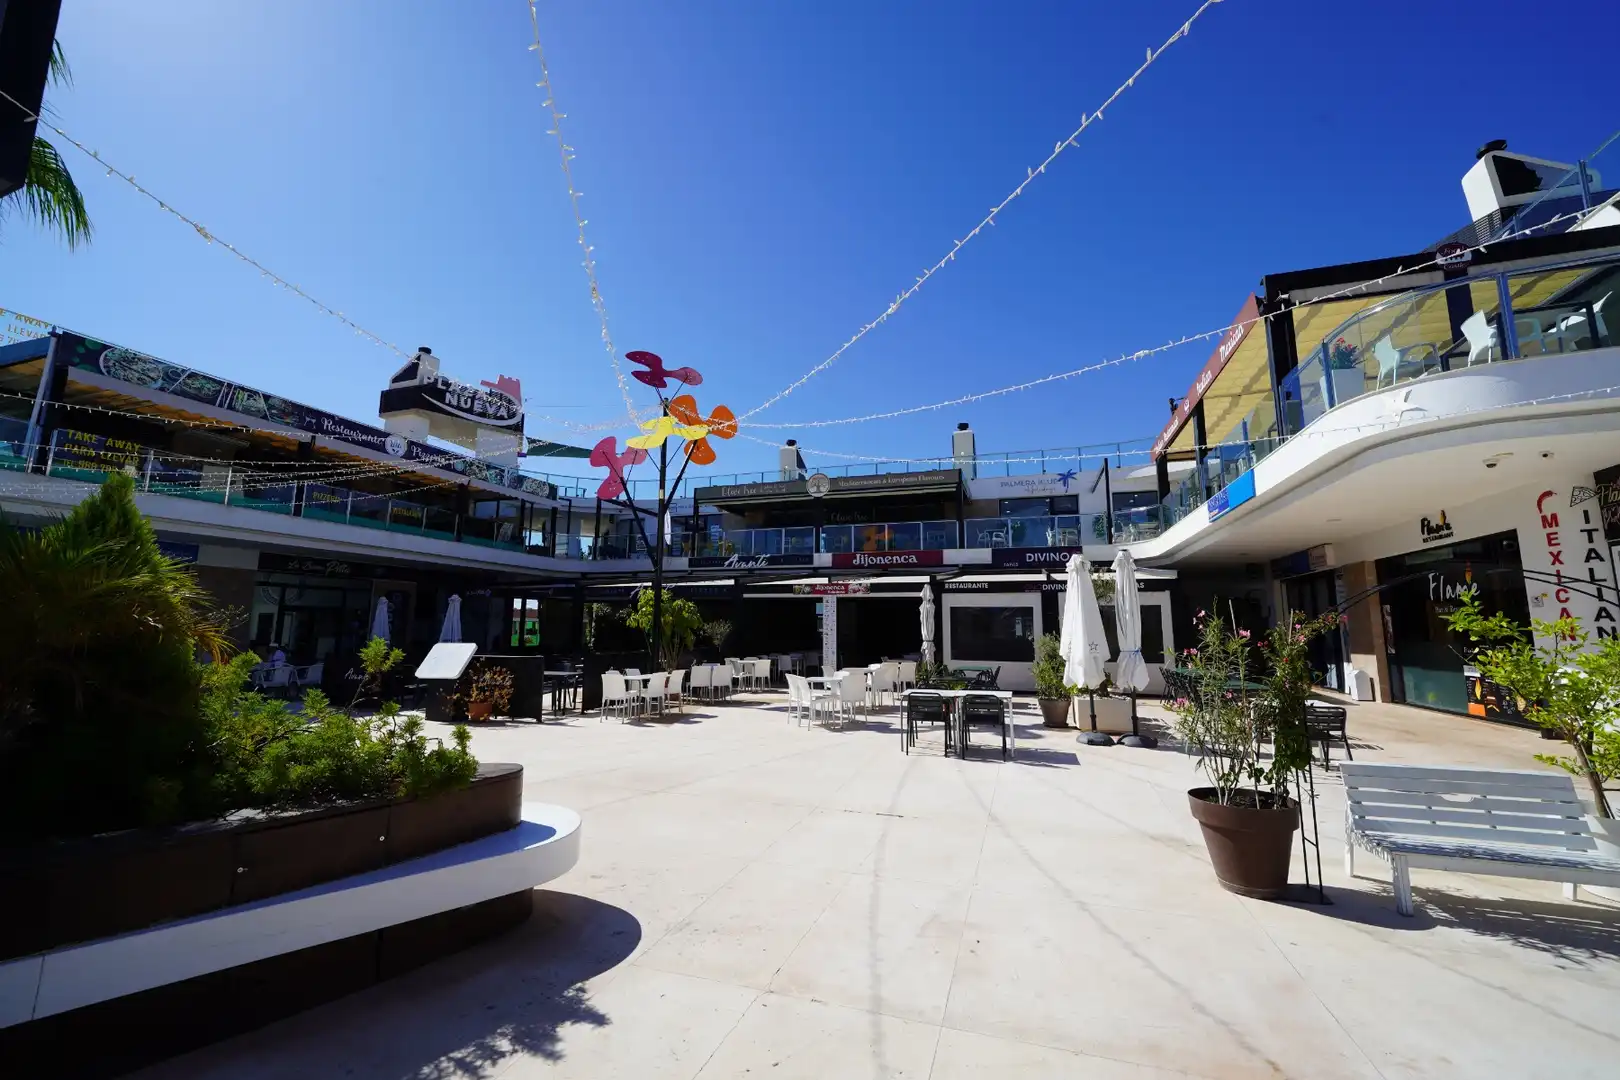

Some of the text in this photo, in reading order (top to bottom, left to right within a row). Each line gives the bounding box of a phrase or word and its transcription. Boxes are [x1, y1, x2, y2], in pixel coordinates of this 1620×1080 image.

[423, 374, 487, 400] PLAZA
[445, 391, 509, 419] NUEVA
[65, 443, 96, 457] PARA
[67, 429, 141, 452] TAKE AWAY
[1000, 479, 1036, 488] PALMERA
[723, 553, 771, 568] Avanti
[852, 553, 918, 567] Jijonenca
[1025, 552, 1070, 563] DIVINO
[1540, 513, 1577, 641] MEXICAN
[1580, 509, 1619, 641] ITALIAN
[944, 582, 989, 590] RESTAURANTE
[1428, 572, 1480, 602] Flame
